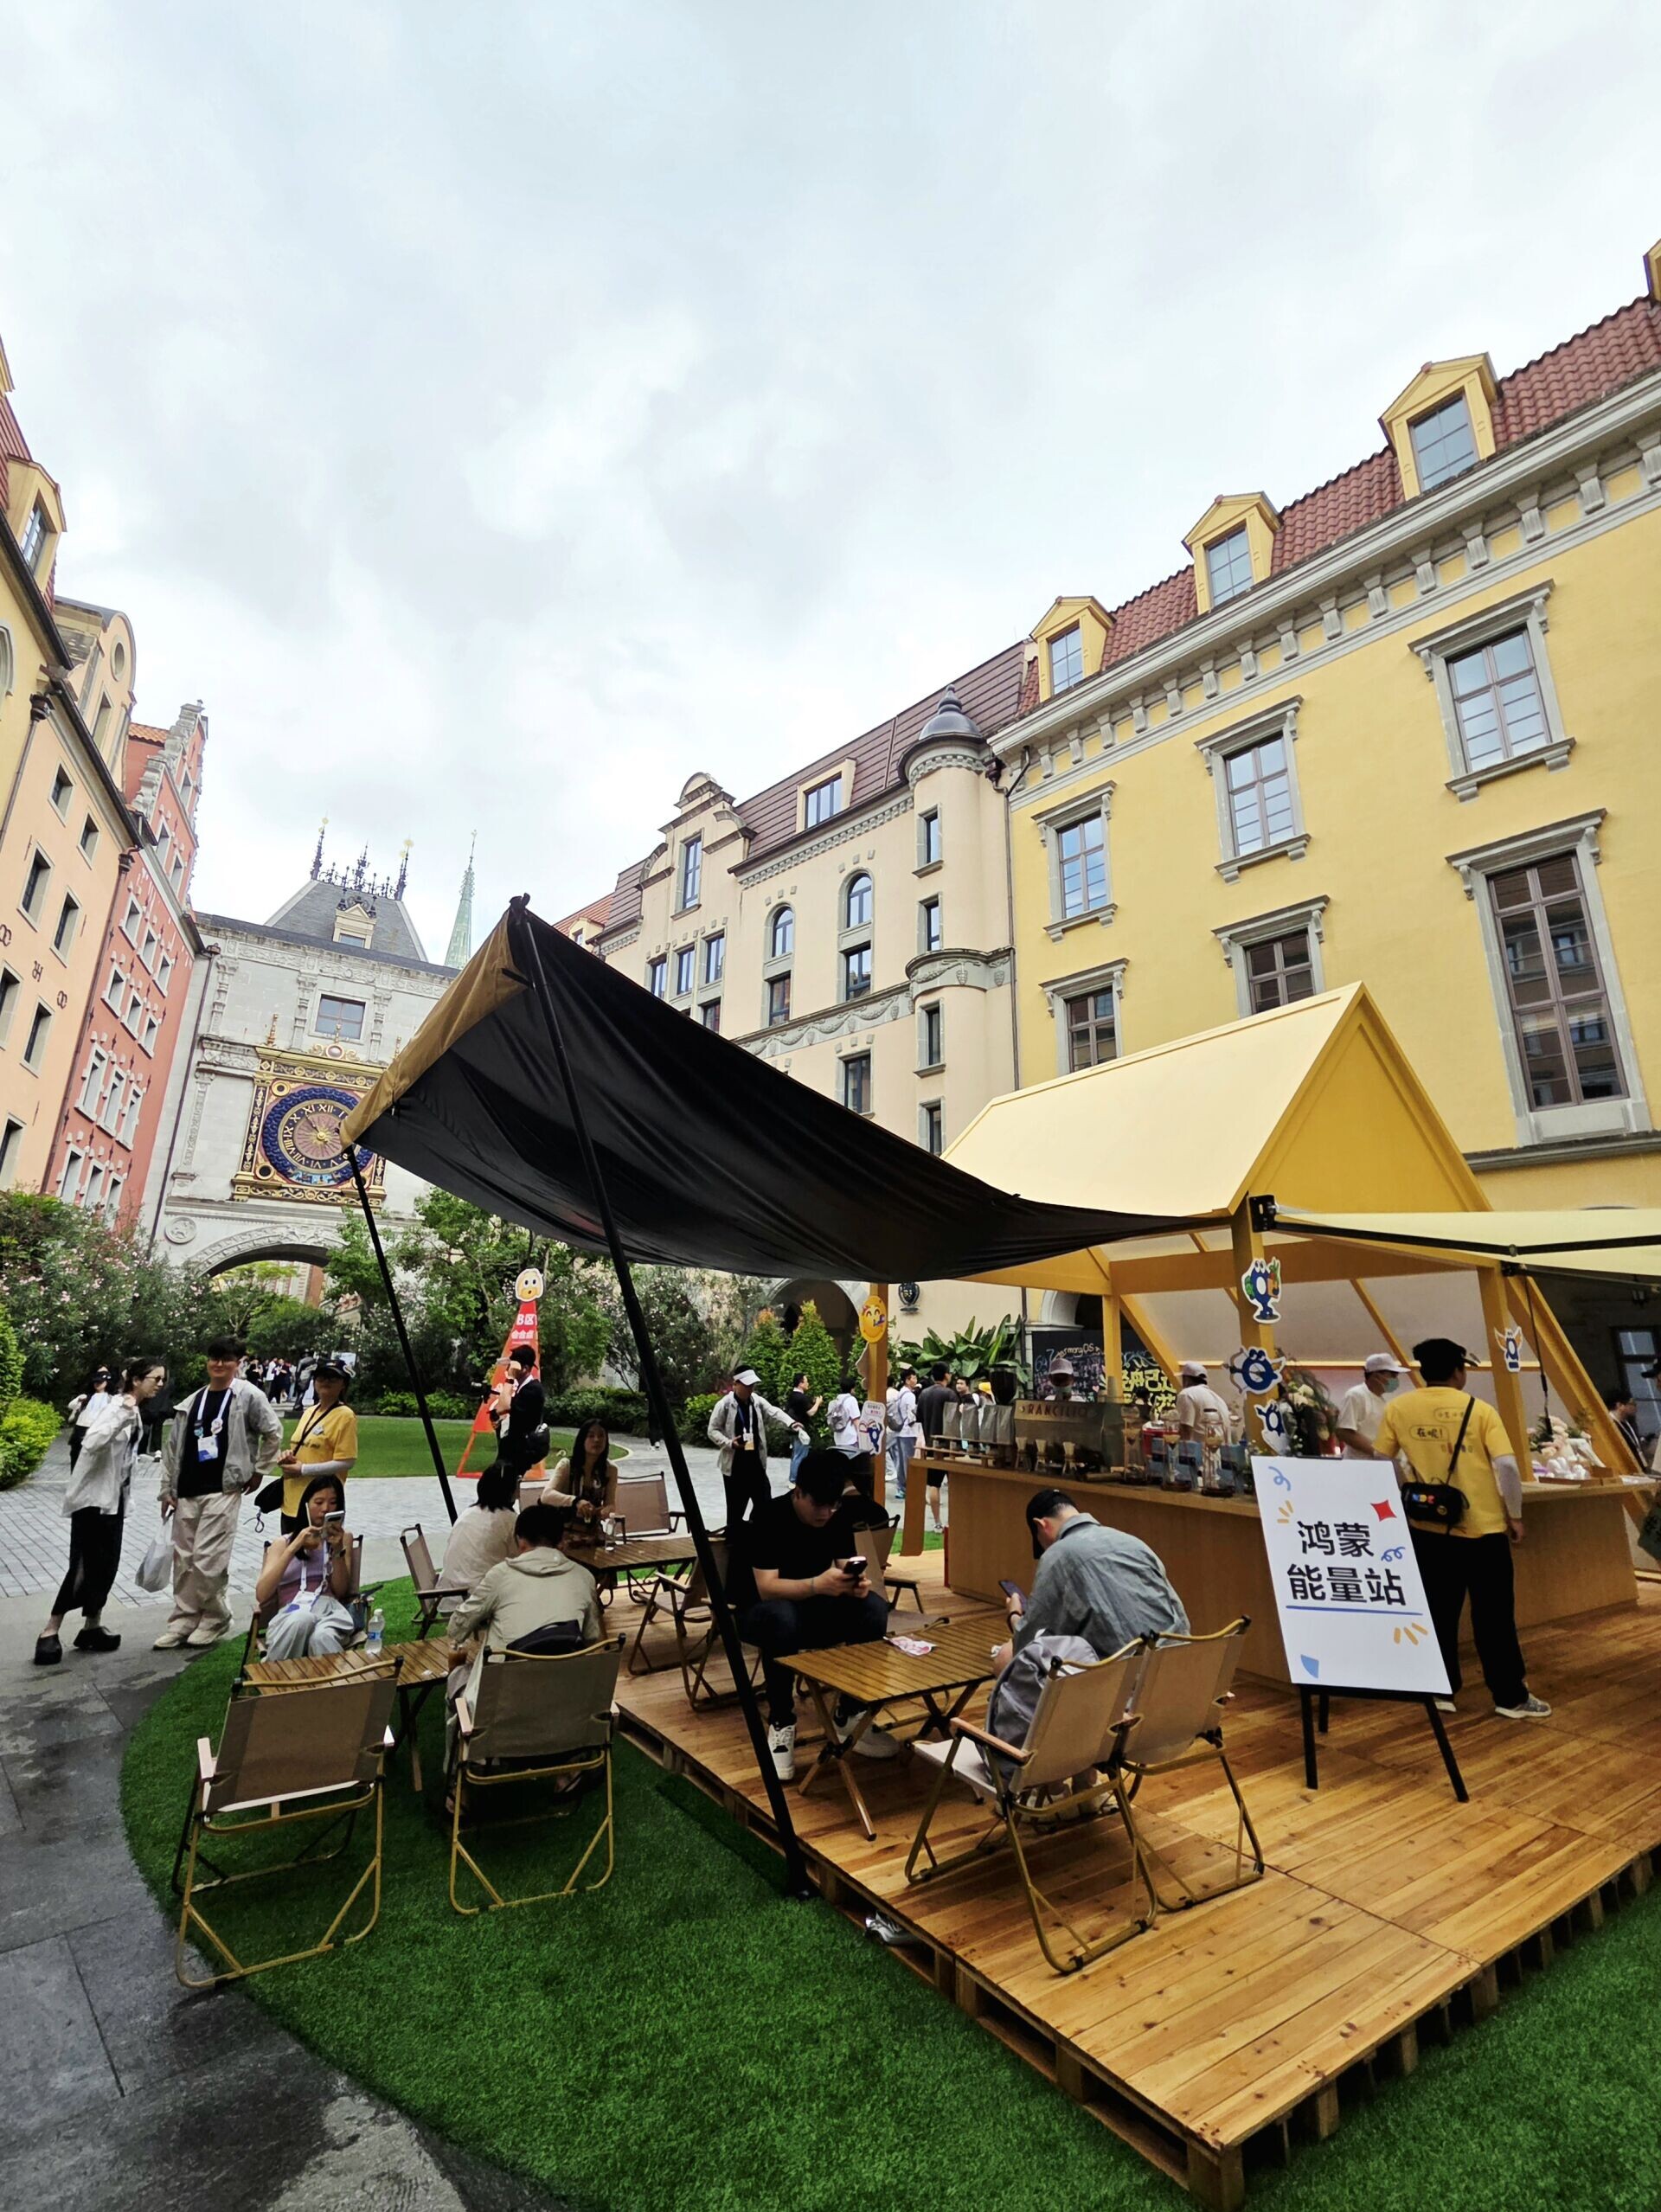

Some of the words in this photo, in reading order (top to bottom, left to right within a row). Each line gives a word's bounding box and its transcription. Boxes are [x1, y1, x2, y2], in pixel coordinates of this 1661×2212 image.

[303, 1105, 315, 1113] XI
[318, 1104, 333, 1113] XII
[290, 1113, 300, 1123] X
[1028, 1403, 1087, 1418] RANCILIO
[1297, 1520, 1375, 1558] 鸿蒙
[1286, 1563, 1407, 1606] 能量站
